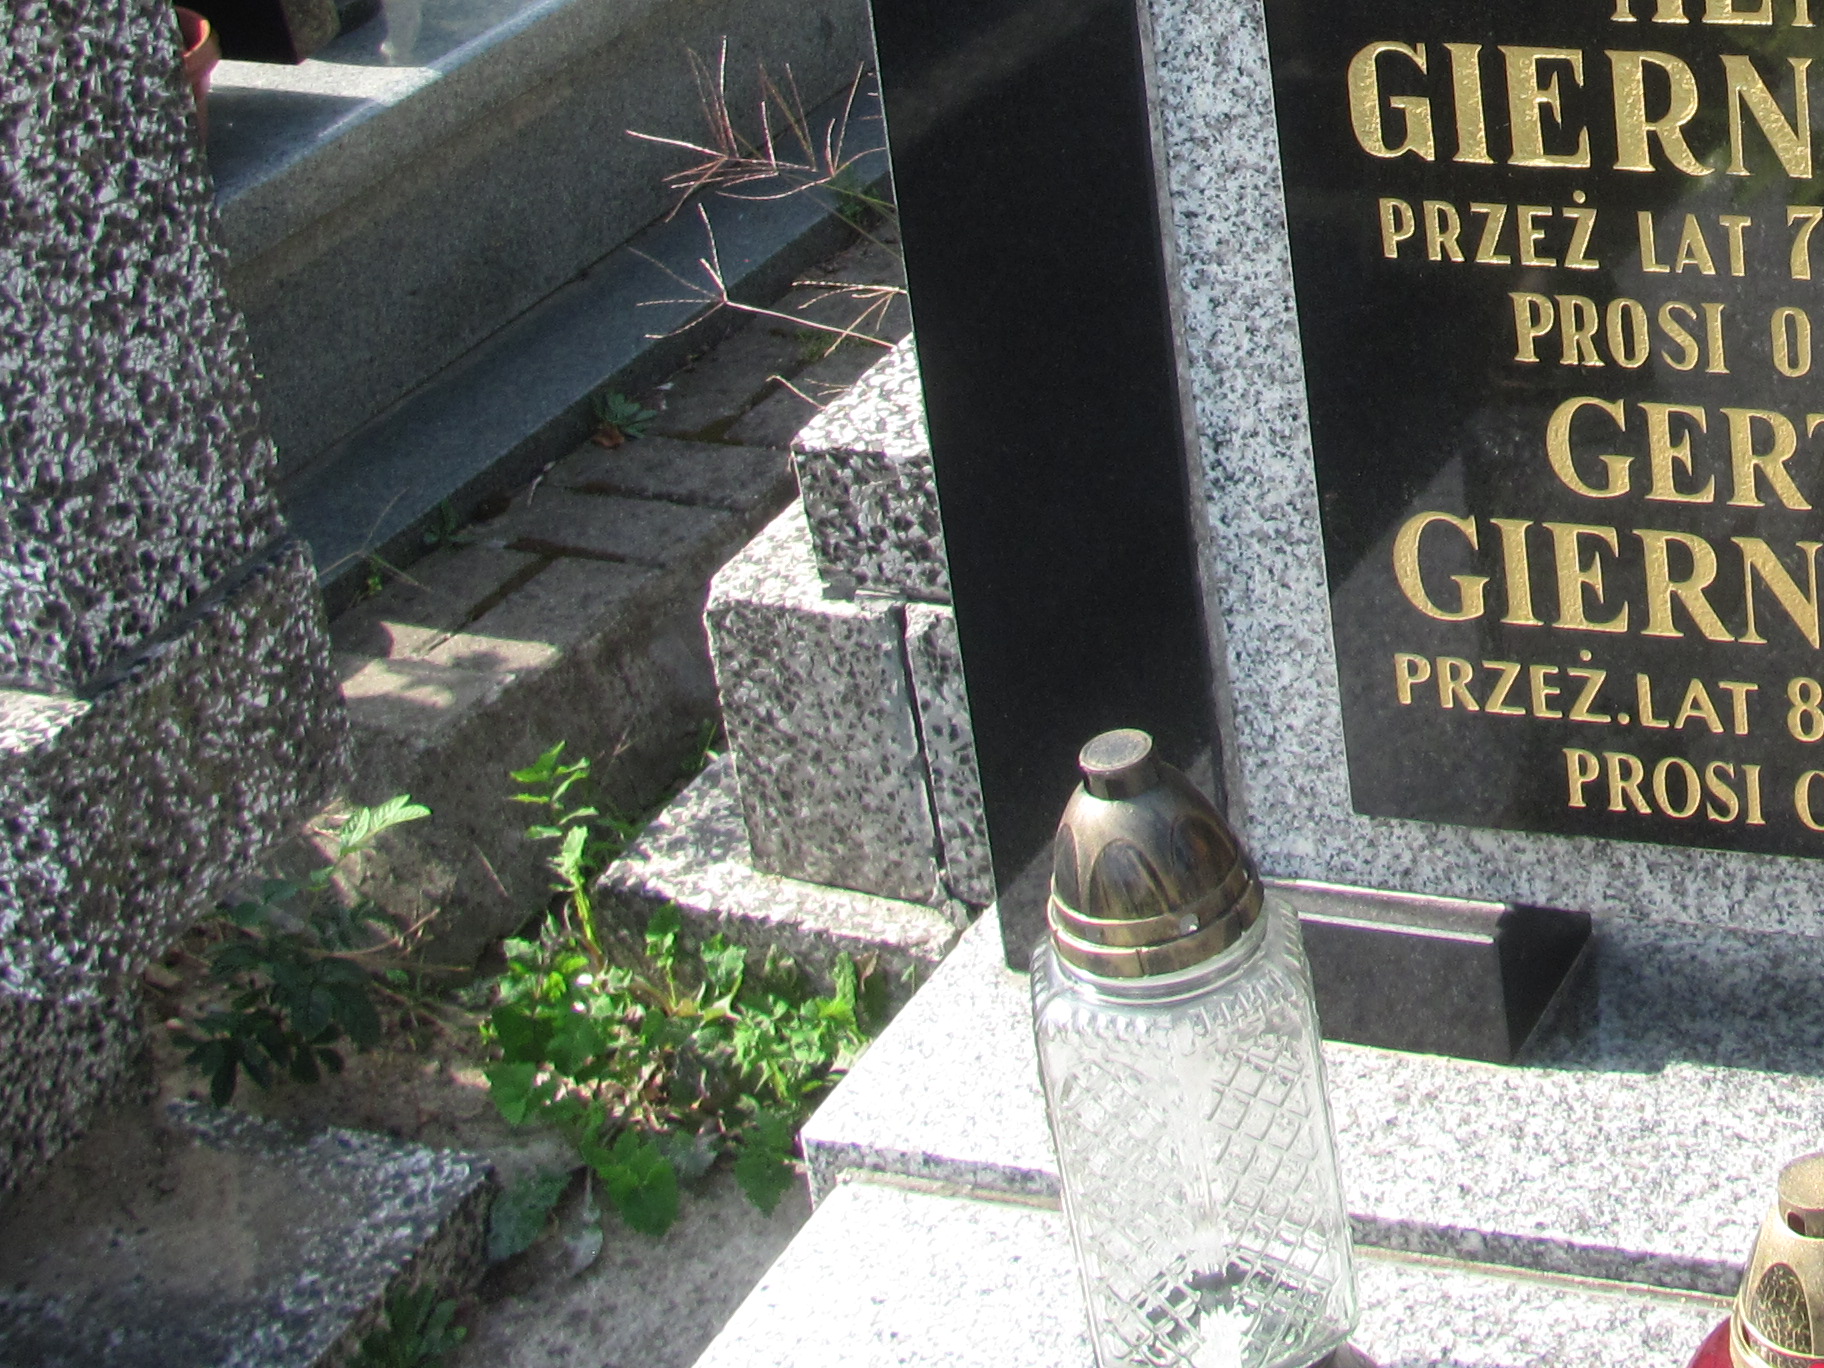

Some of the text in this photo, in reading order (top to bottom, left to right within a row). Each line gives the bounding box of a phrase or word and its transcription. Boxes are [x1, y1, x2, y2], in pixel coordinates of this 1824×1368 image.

[1378, 189, 1600, 271] PRZEŻ
[1636, 210, 1752, 279] LAT
[1508, 290, 1732, 375] PROSI
[1769, 305, 1813, 380] O
[1561, 747, 1768, 826] PROSI
